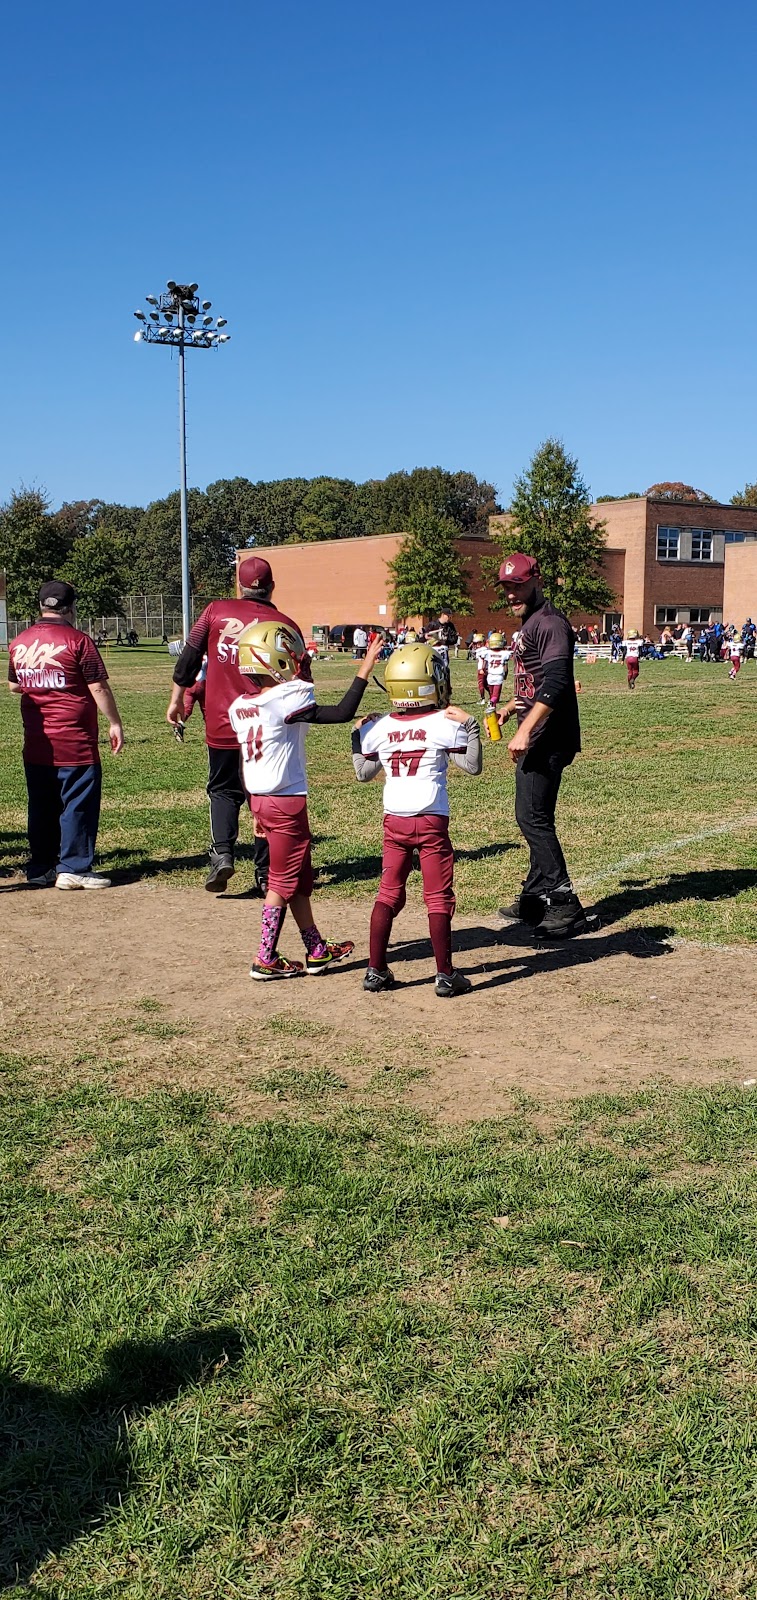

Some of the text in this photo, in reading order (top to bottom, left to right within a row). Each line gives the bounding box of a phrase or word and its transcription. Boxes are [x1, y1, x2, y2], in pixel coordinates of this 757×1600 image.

[12, 638, 67, 670] PACK
[15, 668, 67, 689] STRONG
[245, 725, 264, 763] 11
[387, 728, 427, 744] TAYLOR
[386, 748, 427, 777] 17
